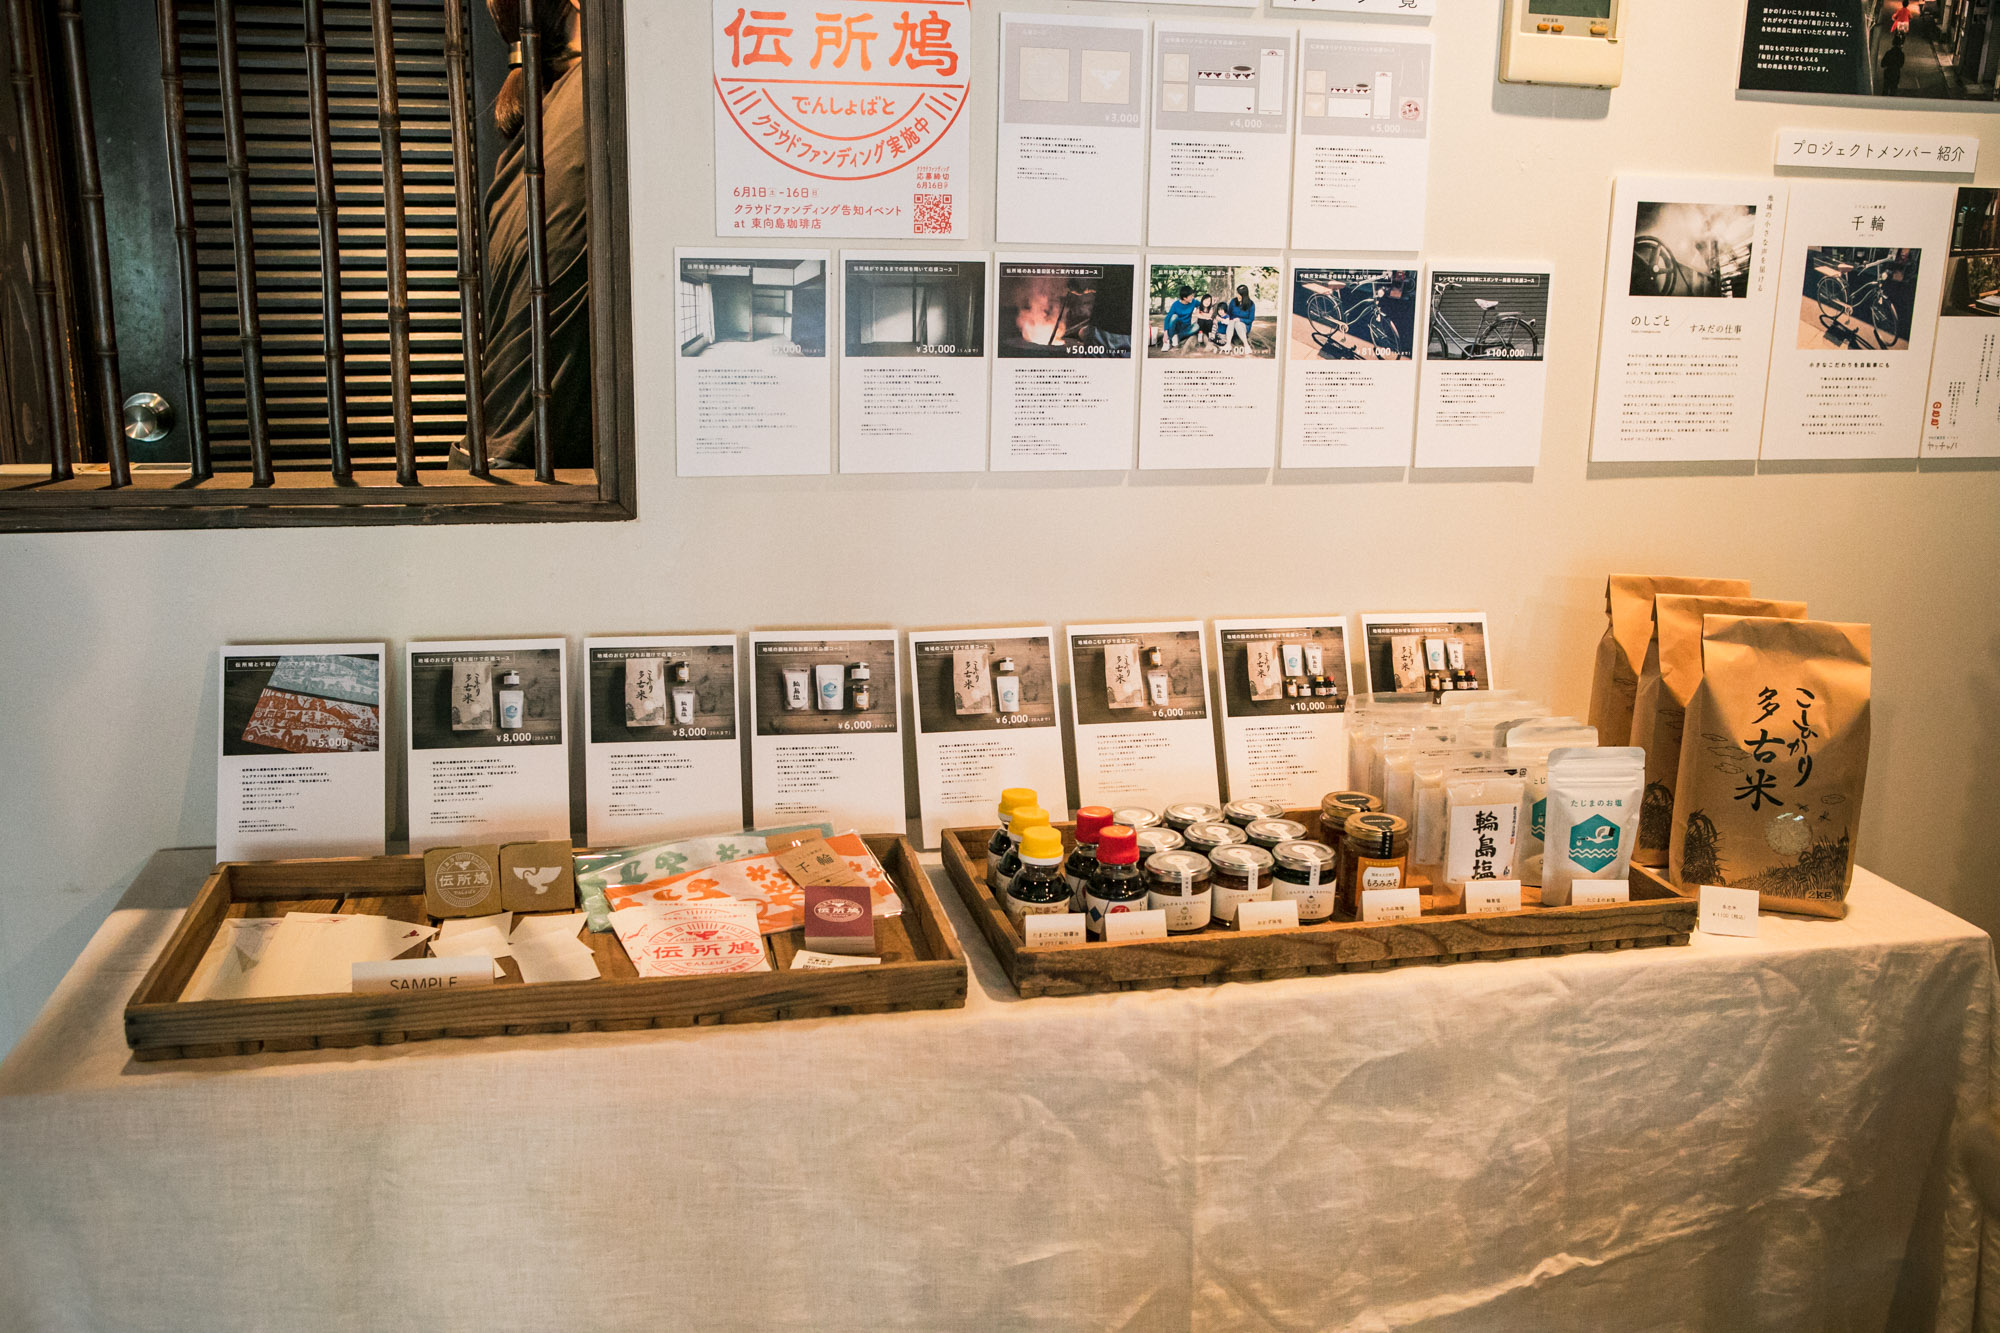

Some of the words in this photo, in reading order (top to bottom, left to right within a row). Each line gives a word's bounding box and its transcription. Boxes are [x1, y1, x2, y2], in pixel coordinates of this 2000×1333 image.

[723, 8, 959, 76] 伝所鳩
[791, 96, 895, 116] でんしょばと
[752, 115, 930, 168] クラウドファンディング実施中
[734, 204, 902, 216] クラウドファンディング告知イベント
[734, 220, 745, 229] at
[751, 218, 822, 230] 東向島珈琲店
[1851, 215, 1886, 232] 千輪
[1631, 315, 1670, 327] のしごと
[1689, 324, 1743, 335] すみだの仕事
[916, 344, 956, 354] ¥30,000
[1066, 345, 1105, 355] ¥50,000
[1290, 701, 1325, 711] ¥10,000
[1152, 708, 1183, 717] ¥6,000
[838, 720, 872, 730] ¥6,000
[996, 715, 1028, 725] ¥6,000
[497, 733, 531, 743] ¥8,000
[673, 727, 707, 738] ¥8,000
[1786, 688, 1819, 788] こしひかり
[311, 737, 348, 748] ¥5,000
[1734, 686, 1786, 812] 多古米
[1570, 799, 1623, 807] たじまのお塩
[1471, 810, 1499, 881] 輪島塩
[439, 871, 490, 887] 伝所鳩
[1367, 879, 1397, 888] もろみみそ
[1808, 890, 1833, 900] 2kg
[652, 940, 760, 959] 伝所鳩
